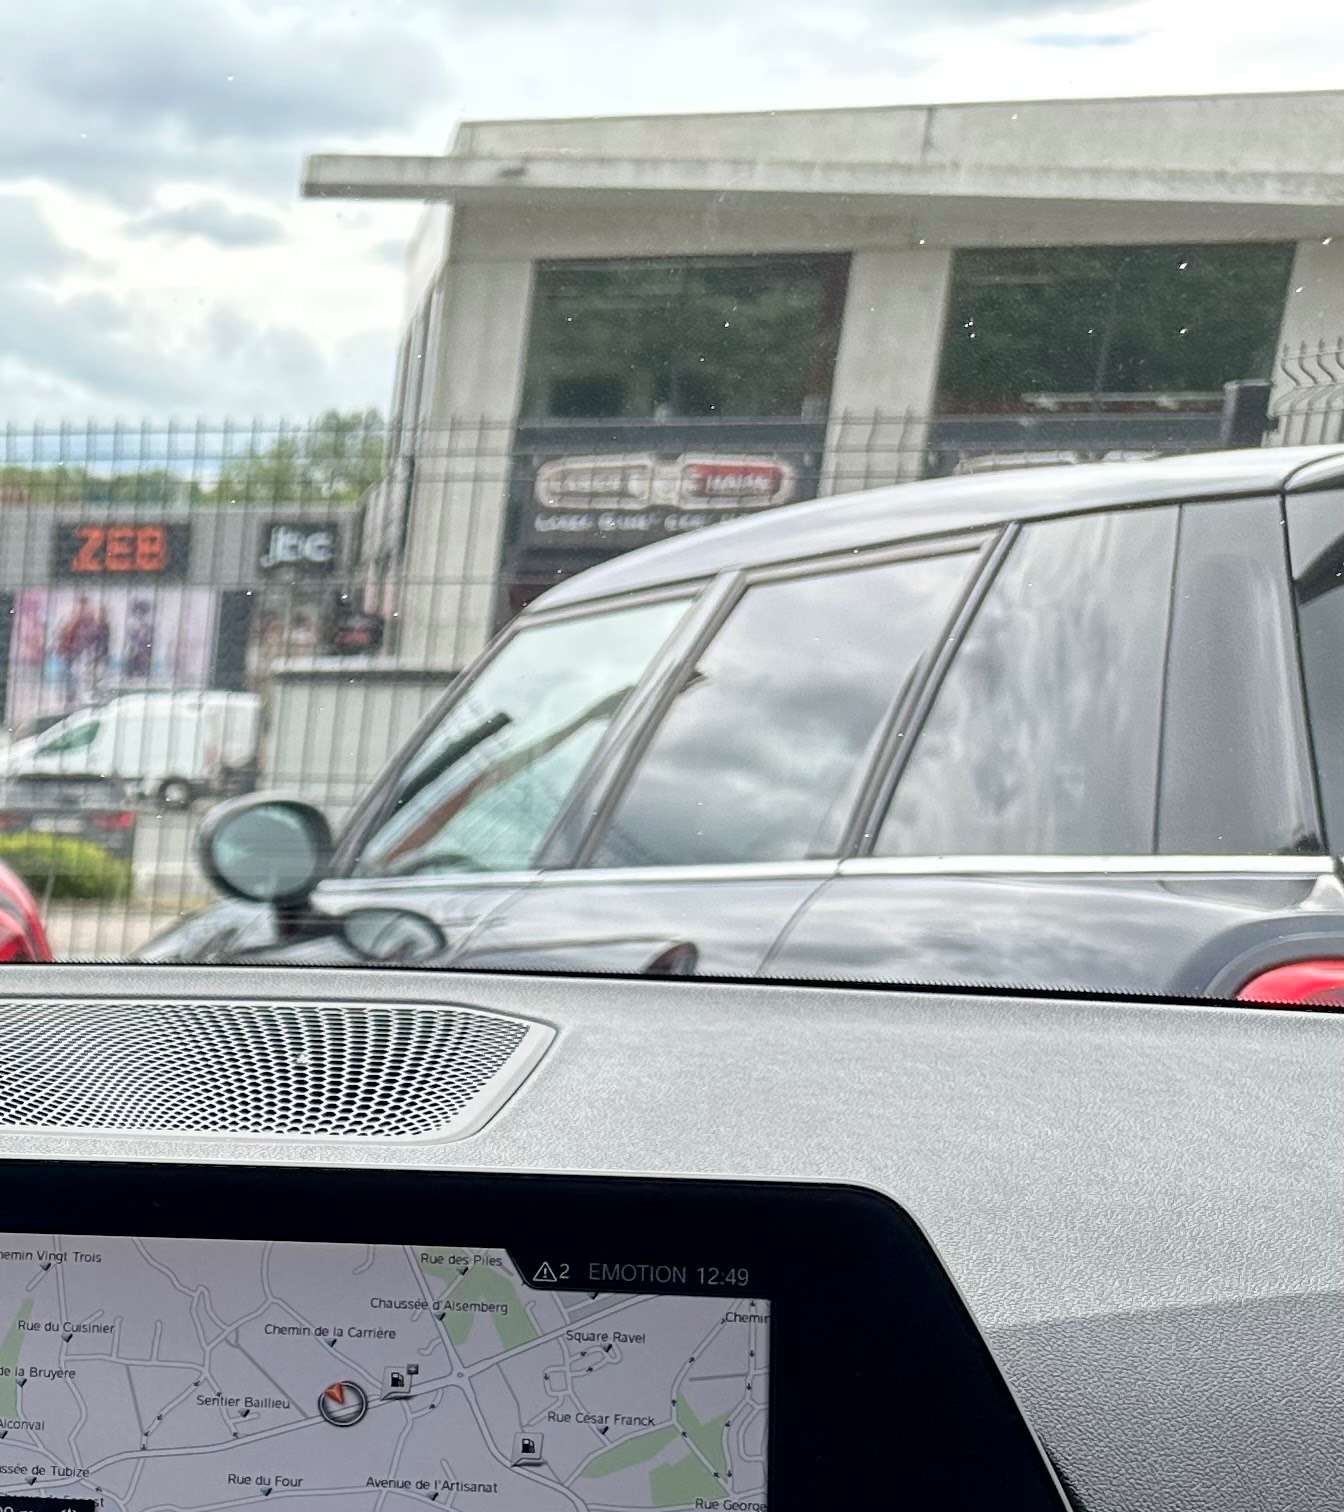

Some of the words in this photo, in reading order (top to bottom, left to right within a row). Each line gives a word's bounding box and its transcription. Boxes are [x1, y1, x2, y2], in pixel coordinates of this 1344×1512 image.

[71, 524, 168, 572] ZEB
[36, 1250, 68, 1265] Vingt
[72, 1251, 102, 1263] Trois
[420, 1253, 445, 1265] Rue
[448, 1254, 469, 1265] des
[473, 1255, 503, 1267] Piles
[559, 1263, 570, 1280] 2
[588, 1263, 687, 1284] EMOTION
[697, 1267, 749, 1287] 12:49
[370, 1297, 429, 1311] Chaussée
[432, 1298, 509, 1315] d'Alsemberg
[18, 1320, 41, 1331] Rue
[44, 1321, 59, 1332] du
[63, 1322, 114, 1333] Cuisinier
[264, 1323, 310, 1336] Chemin
[314, 1325, 329, 1337] de
[333, 1326, 343, 1337] la
[347, 1326, 396, 1339] Carrière
[566, 1330, 609, 1345] Square
[613, 1331, 646, 1344] Ravel
[15, 1366, 25, 1377] la
[29, 1367, 76, 1380] Bruyère
[196, 1395, 239, 1407] Sentier
[244, 1396, 290, 1409] Baillieu
[547, 1411, 572, 1423] Rue
[575, 1411, 609, 1425] César
[614, 1414, 656, 1426] Franck
[31, 1463, 46, 1476] de
[52, 1465, 90, 1478] Tubize
[227, 1473, 251, 1485] Rue
[255, 1475, 271, 1486] du
[274, 1475, 303, 1488] Four
[366, 1476, 411, 1490] Avenue
[415, 1479, 430, 1490] de
[433, 1479, 498, 1493] l'Artisanat
[695, 1498, 720, 1510] Rue
